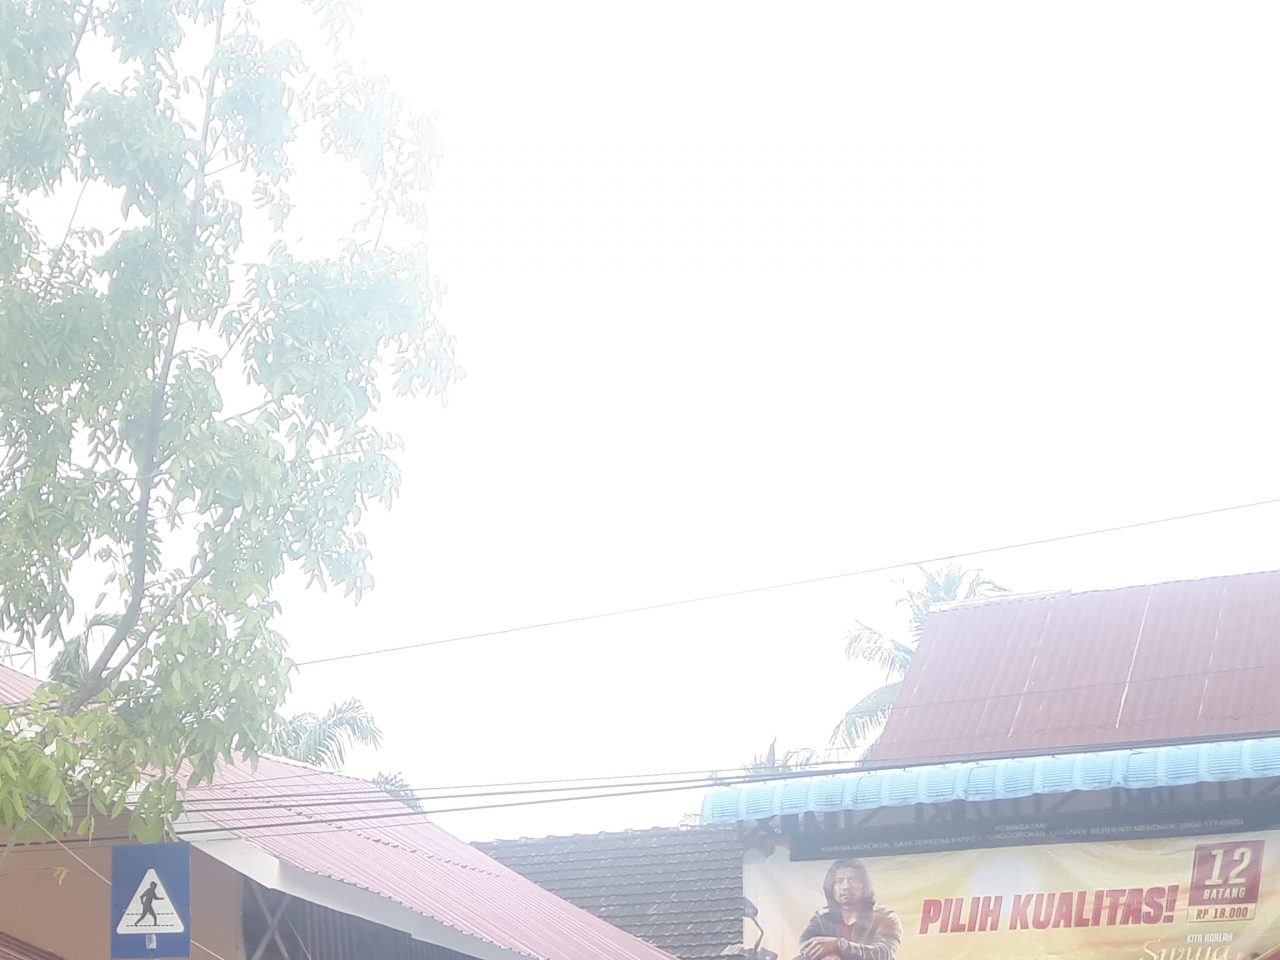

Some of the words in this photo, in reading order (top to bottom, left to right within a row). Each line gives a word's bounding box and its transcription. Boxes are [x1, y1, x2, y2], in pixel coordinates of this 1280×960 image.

[1204, 846, 1252, 886] 12
[1203, 887, 1246, 900] BATANG
[919, 895, 1004, 935] PILIH
[1008, 885, 1180, 931] KUALITAS!
[1195, 909, 1209, 920] RP
[1212, 907, 1249, 919] 18.000
